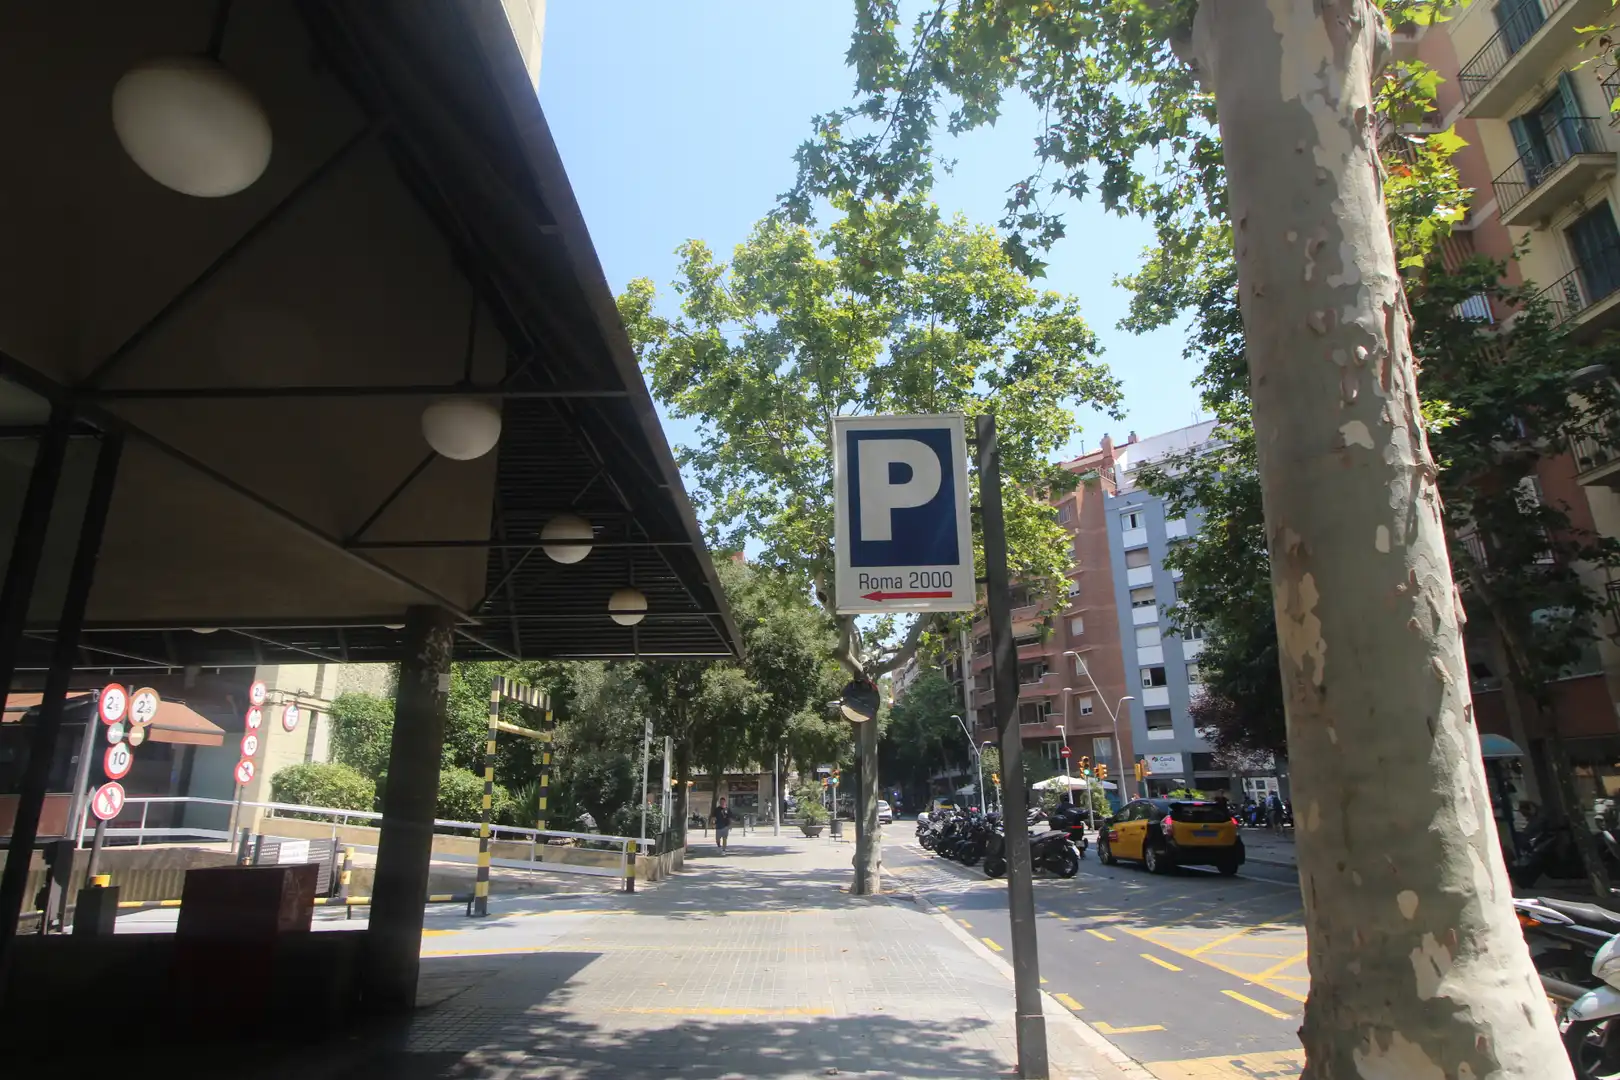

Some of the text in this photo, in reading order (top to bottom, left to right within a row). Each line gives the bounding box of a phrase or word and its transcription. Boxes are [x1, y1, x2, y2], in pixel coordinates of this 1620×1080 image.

[858, 440, 941, 541] P
[859, 571, 953, 590] Roma 2000
[113, 751, 127, 766] 10
